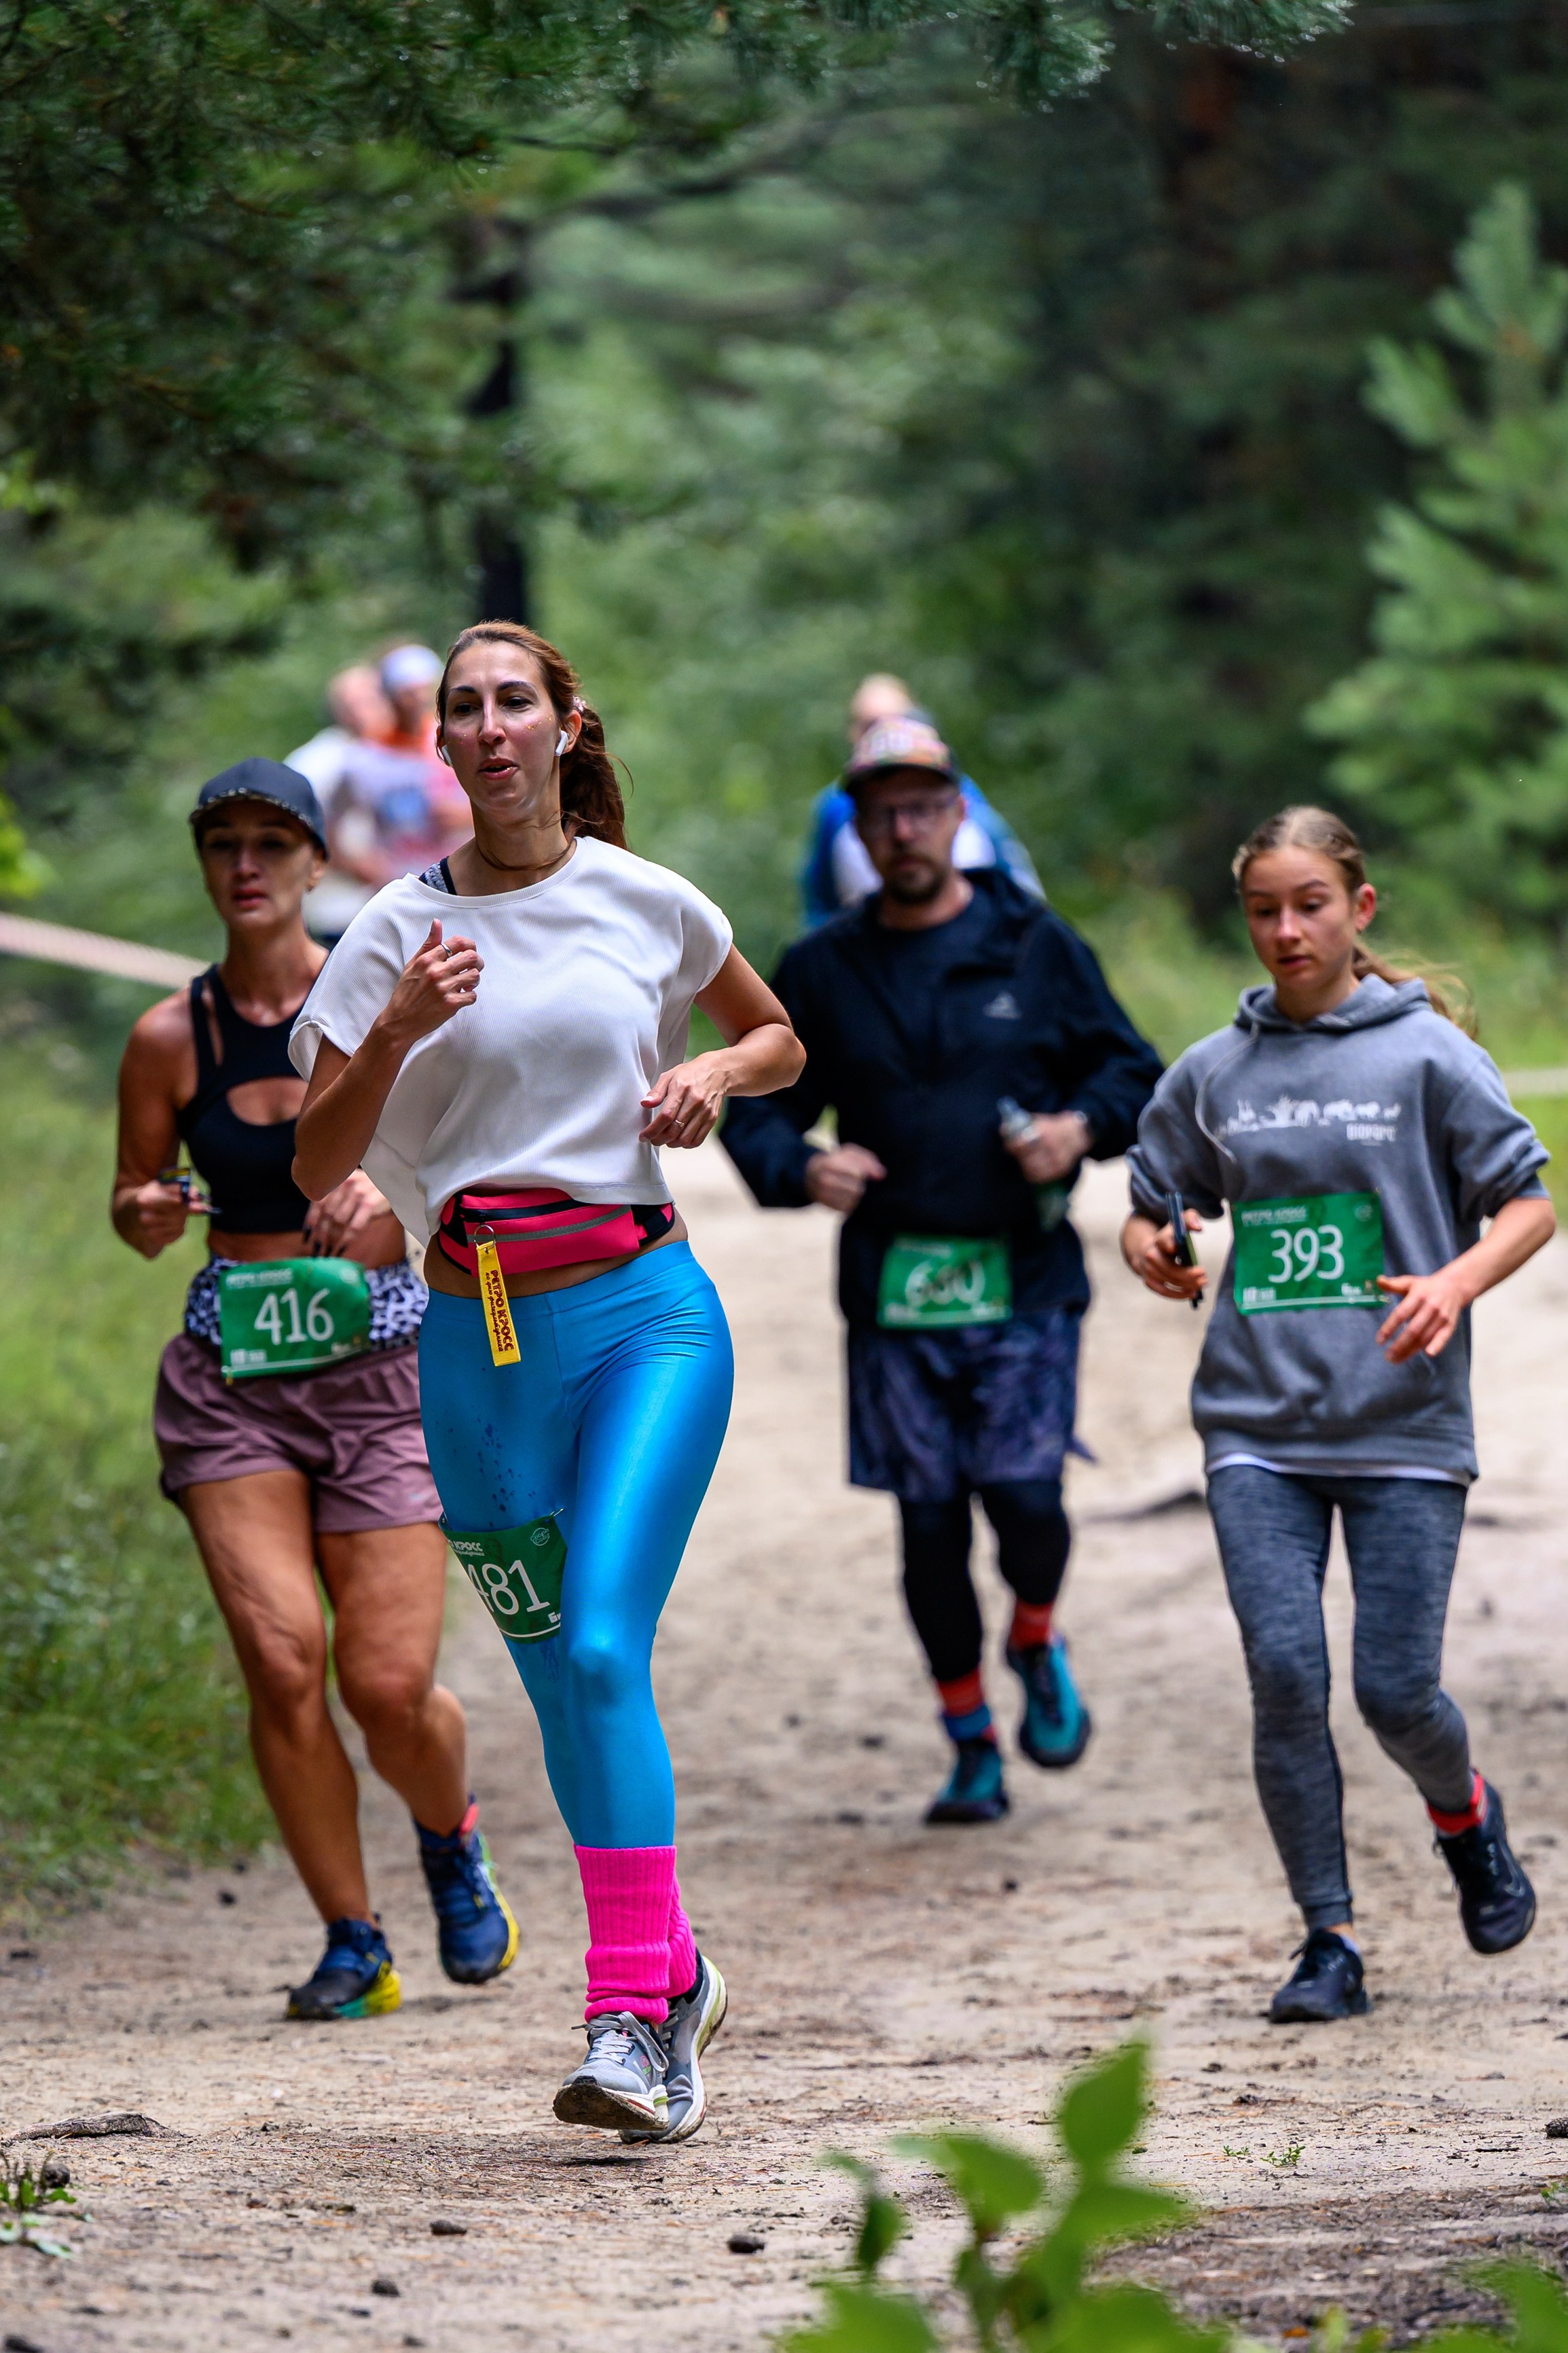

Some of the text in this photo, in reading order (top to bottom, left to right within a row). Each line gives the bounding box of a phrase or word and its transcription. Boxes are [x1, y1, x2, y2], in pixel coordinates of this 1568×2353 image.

[1268, 1224, 1345, 1283] 393
[254, 1288, 335, 1346] 416
[490, 1270, 514, 1351] РЕТРО КРОСС
[468, 1560, 551, 1615] 481
